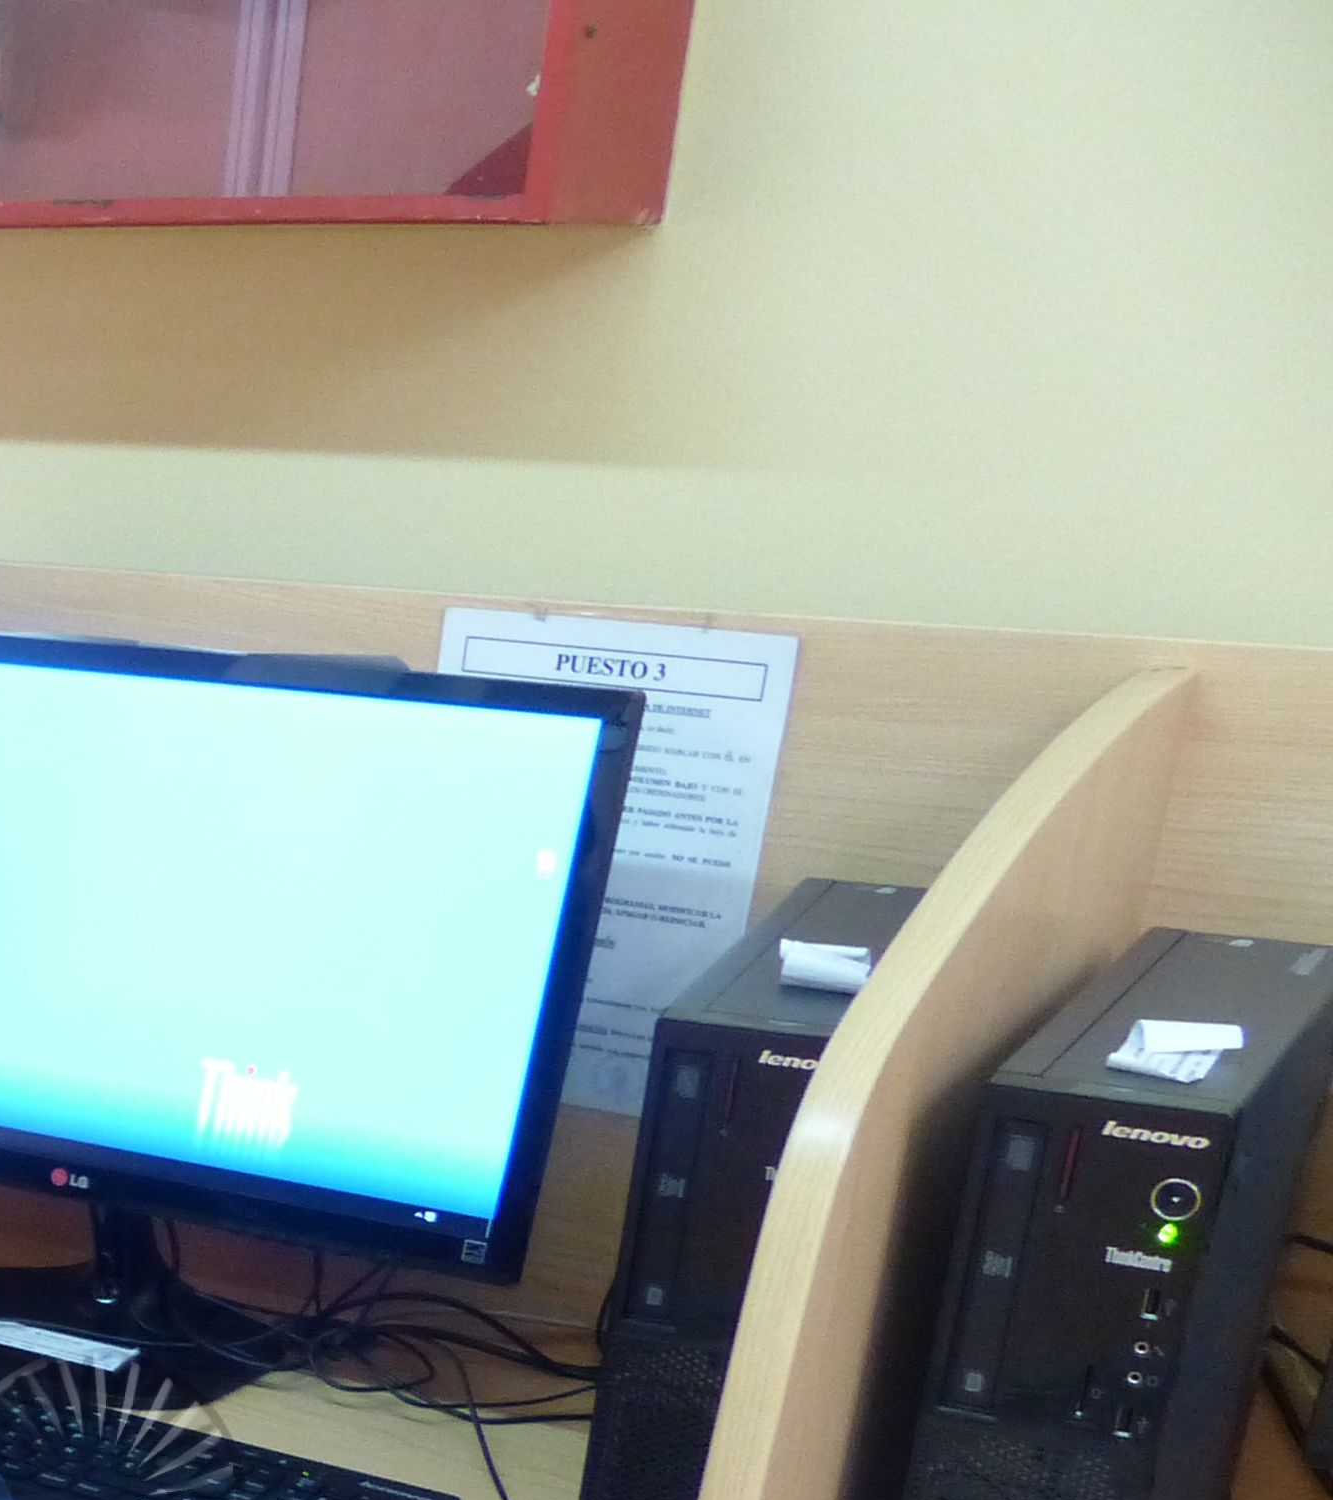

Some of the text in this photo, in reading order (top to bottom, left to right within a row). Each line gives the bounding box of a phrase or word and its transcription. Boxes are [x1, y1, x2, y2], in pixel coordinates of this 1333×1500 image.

[555, 653, 667, 682] PUESTO 3
[665, 705, 711, 718] INTERNET
[758, 1050, 819, 1071] leno
[1102, 1120, 1211, 1149] lenovo
[69, 1173, 90, 1189] LG
